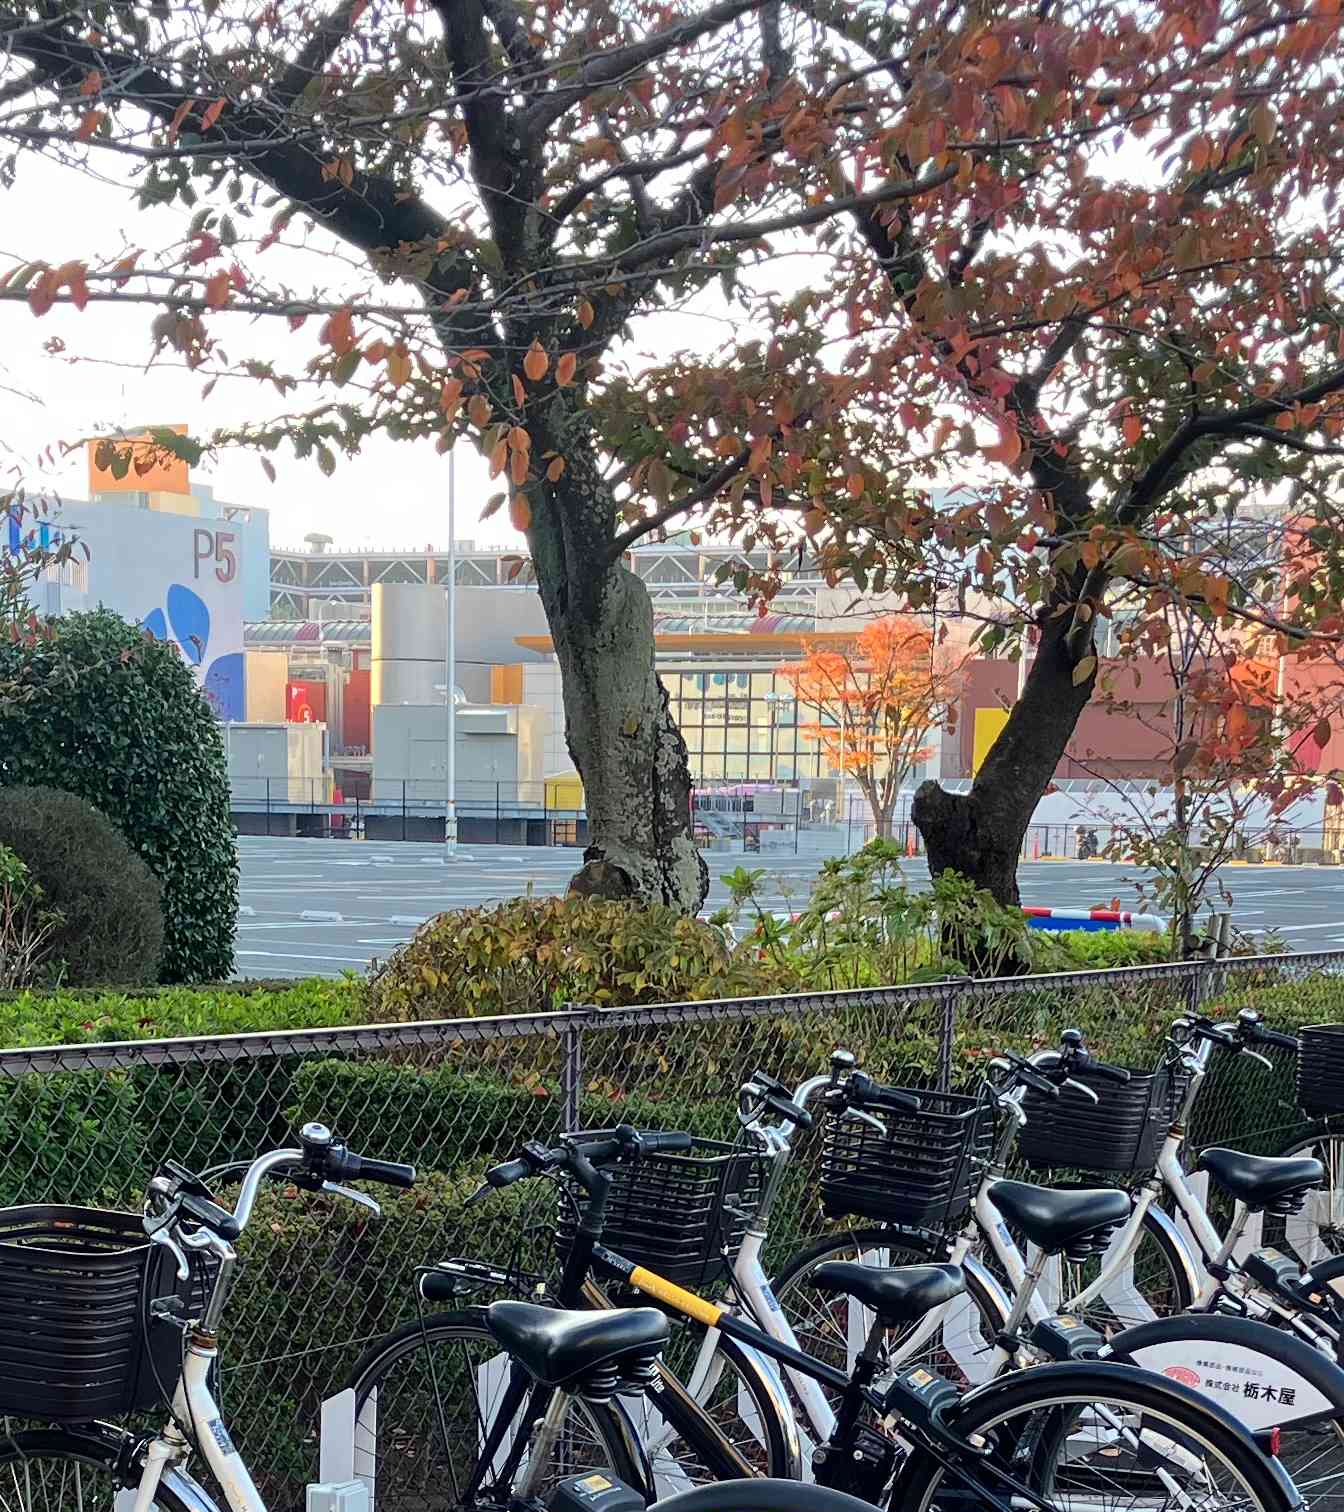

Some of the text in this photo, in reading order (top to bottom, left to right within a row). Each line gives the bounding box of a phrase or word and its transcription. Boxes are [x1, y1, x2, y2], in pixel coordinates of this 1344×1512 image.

[193, 528, 237, 584] P5
[1205, 1378, 1297, 1407] 株式会社 栃木屋
